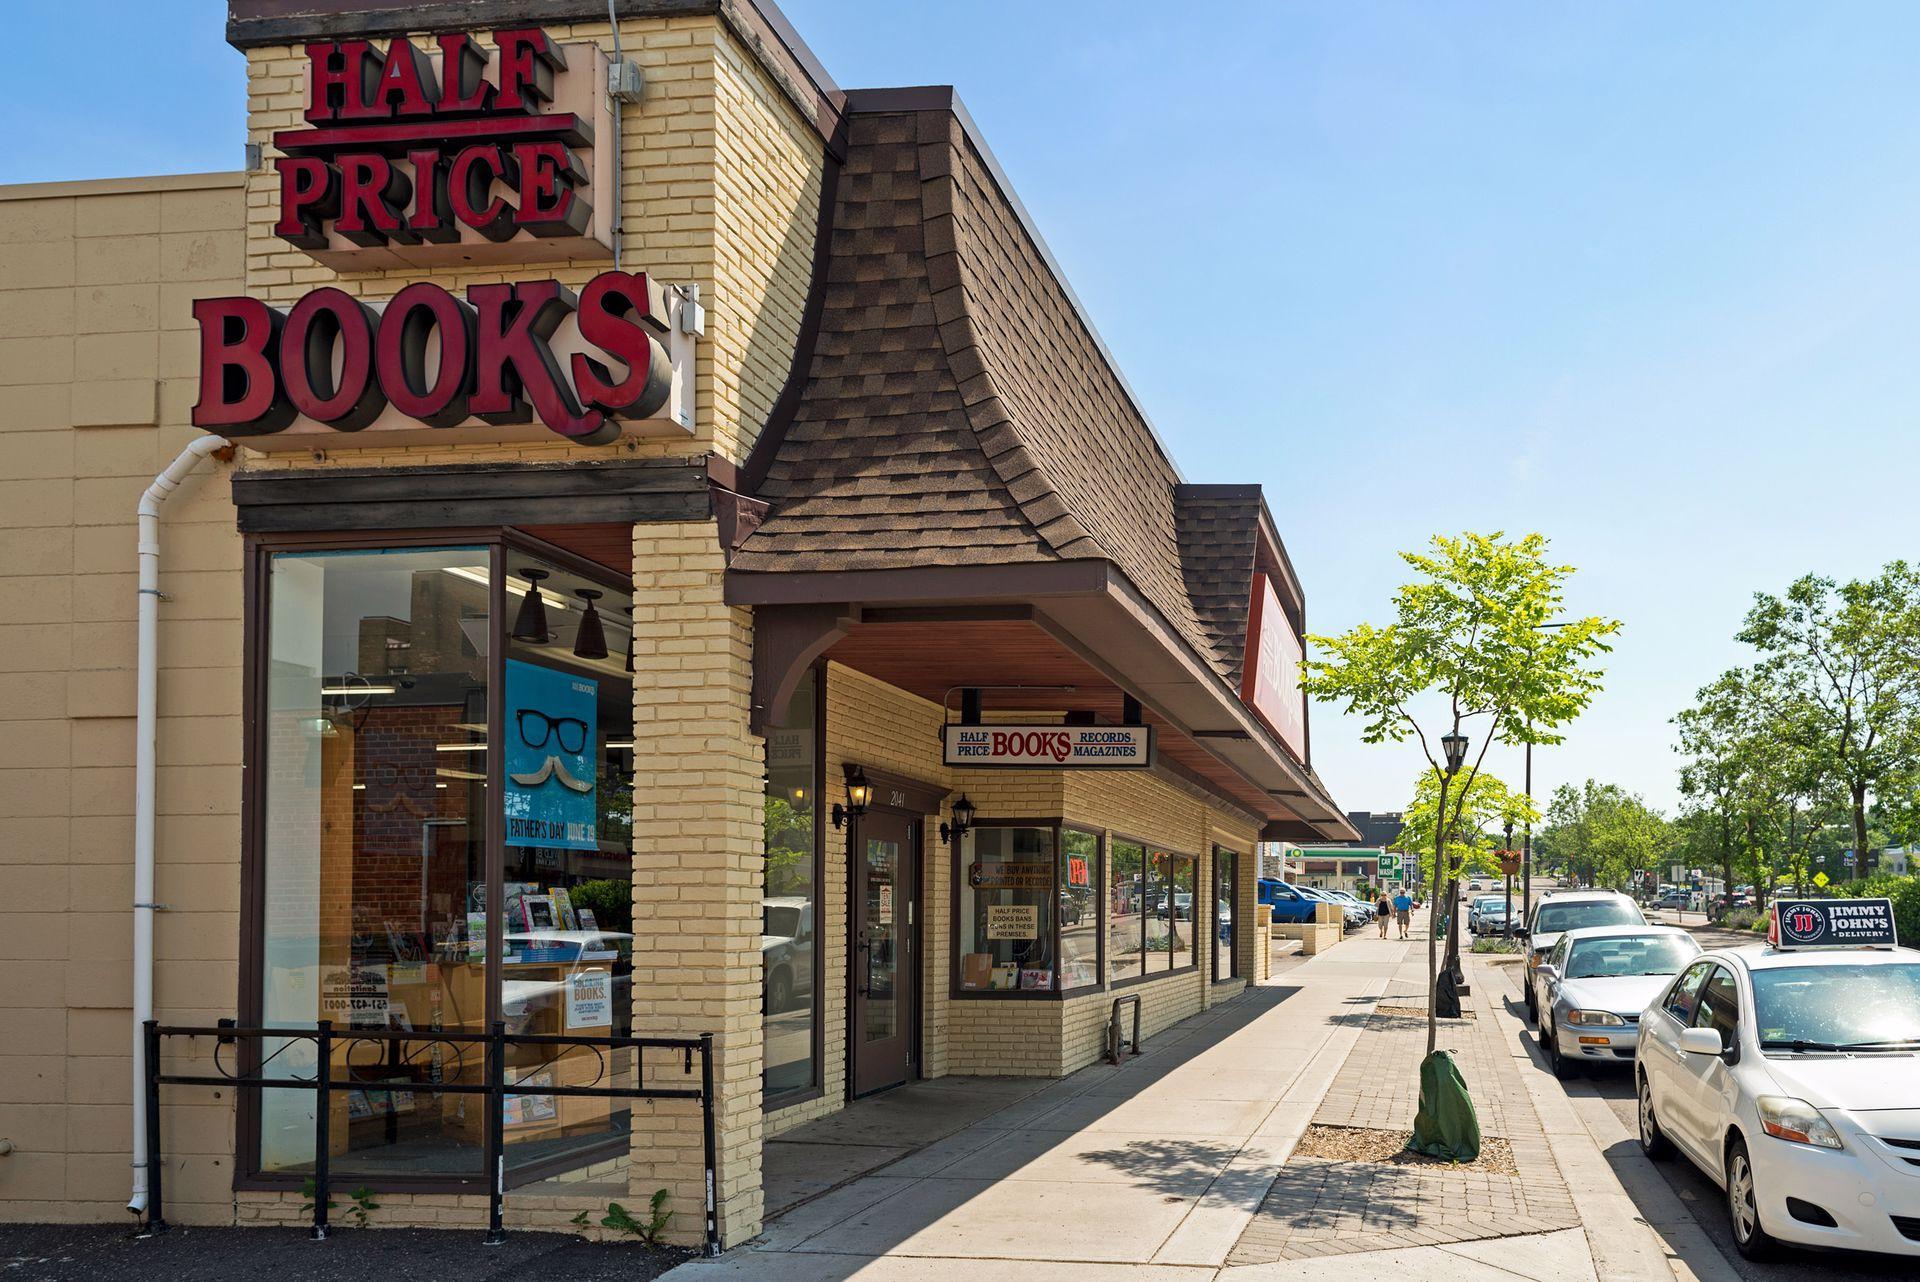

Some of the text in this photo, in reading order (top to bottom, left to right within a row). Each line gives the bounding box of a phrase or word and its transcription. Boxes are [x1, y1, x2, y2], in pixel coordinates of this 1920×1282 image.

[304, 28, 560, 124] HALF
[275, 141, 580, 240] PRICE
[191, 271, 656, 440] BOOKS
[960, 732, 989, 743] HALF
[1079, 732, 1132, 743] RECORDS
[957, 745, 990, 757] PRICE
[991, 732, 1072, 763] BOOKS
[1073, 746, 1137, 757] MAGAZINES
[510, 818, 595, 842] FATHER'S DAY JUNE 19
[1381, 858, 1391, 866] CAR
[1379, 868, 1393, 876] WASH
[1828, 905, 1886, 919] JIMMY
[1793, 914, 1813, 932] JJ
[1830, 918, 1889, 933] JOHN'S
[574, 987, 607, 1001] BOOKS.
